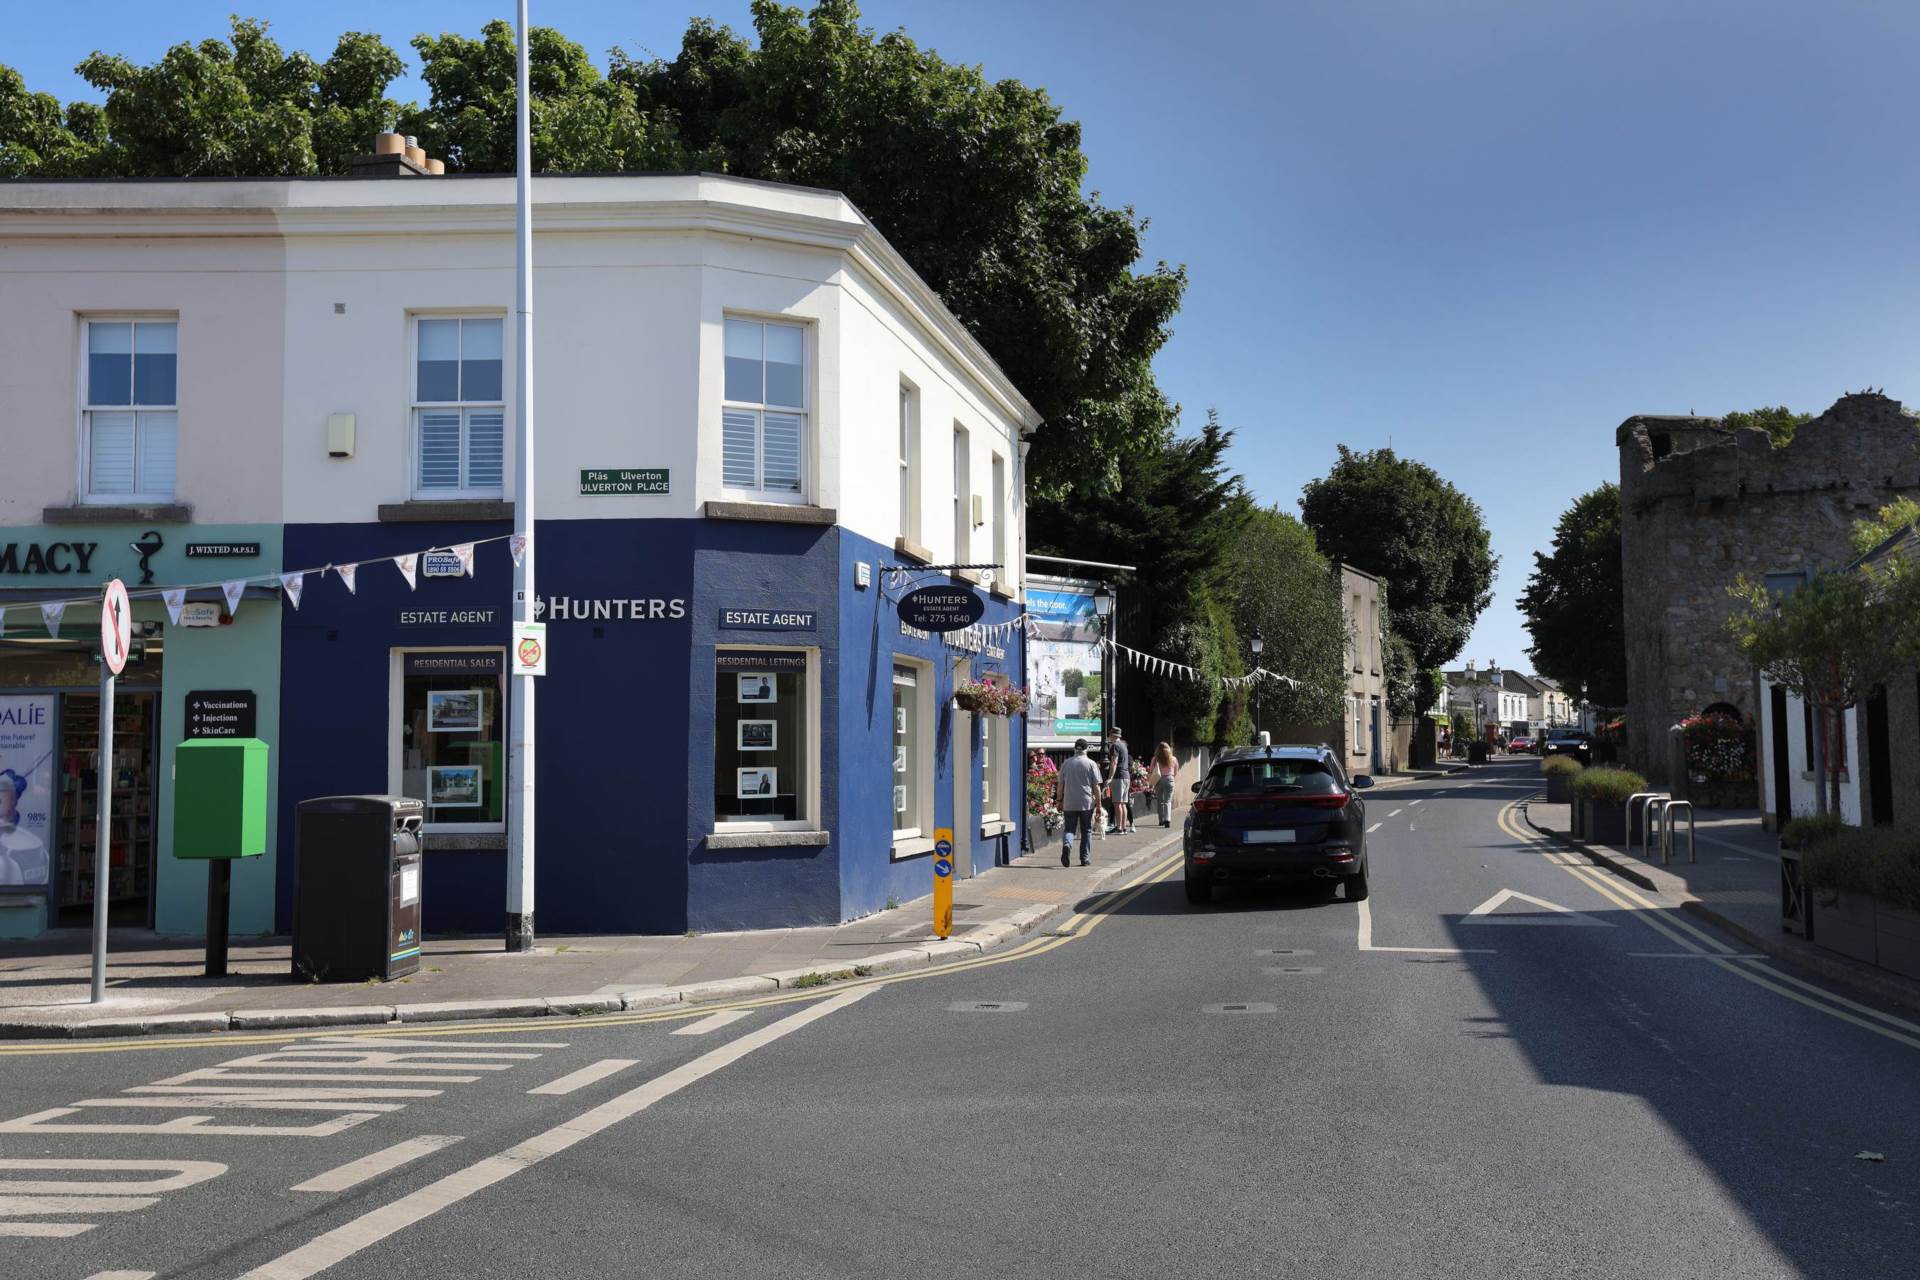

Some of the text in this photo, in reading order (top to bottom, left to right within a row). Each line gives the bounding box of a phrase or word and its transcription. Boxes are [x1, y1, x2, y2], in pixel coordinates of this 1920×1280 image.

[588, 471, 662, 480] Plás Ulverton
[581, 482, 669, 492] ULVERTON PLACE
[919, 594, 968, 604] HUNTERS
[550, 596, 685, 620] HUNTERS
[401, 611, 494, 623] ESTATE AGENT
[726, 611, 812, 626] ESTATE AGENT
[913, 614, 970, 623] Tel: 275 1640
[414, 658, 496, 668] RESIDENTIAL SALES
[717, 656, 806, 667] RESIDENTIAL LETTINGS
[203, 701, 248, 709] Vaccinations
[0, 703, 46, 725] ALÍE
[202, 714, 238, 722] Injections
[202, 726, 236, 734] SkinCare
[0, 1036, 571, 1138] ENTRY
